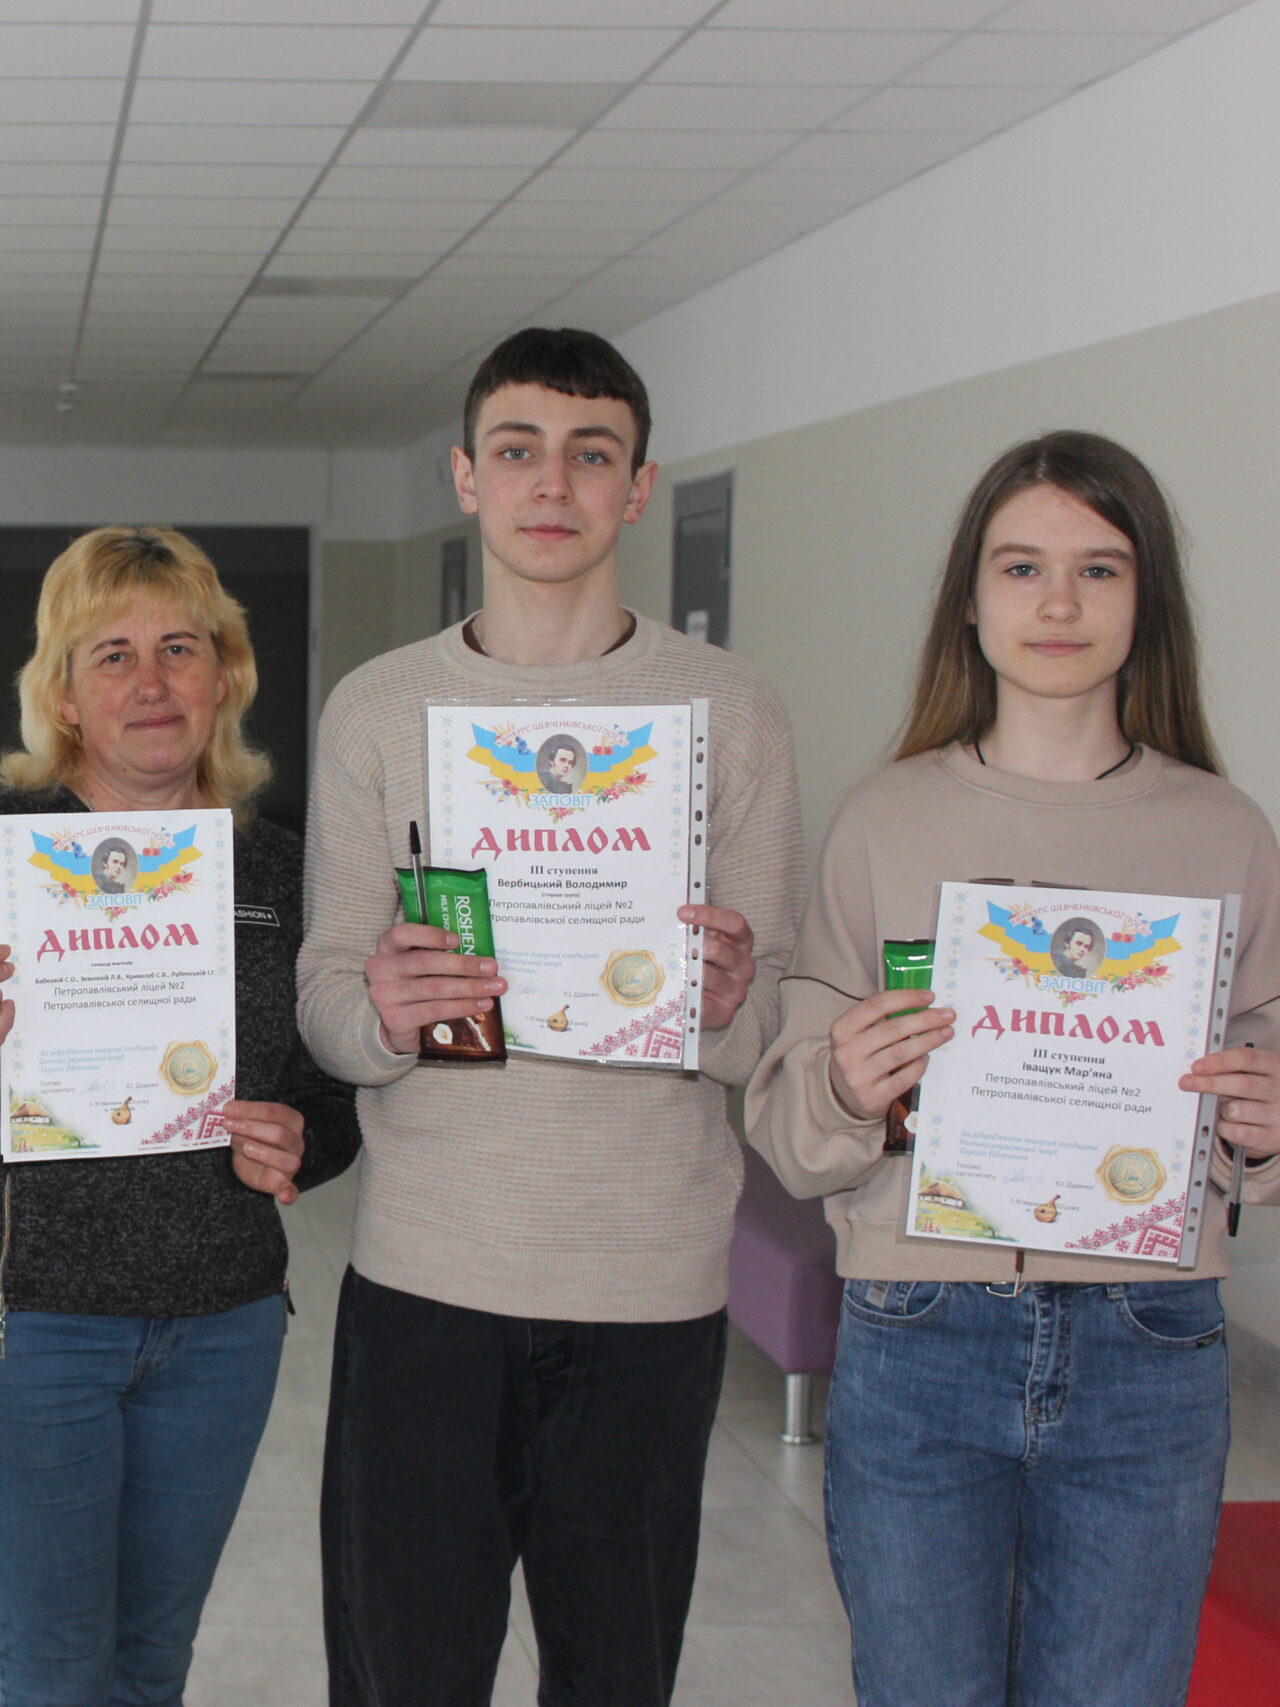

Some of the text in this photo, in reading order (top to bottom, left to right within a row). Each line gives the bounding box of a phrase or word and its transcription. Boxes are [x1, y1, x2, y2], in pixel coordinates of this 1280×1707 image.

[532, 721, 602, 735] ШЕВЧЕНКІВСЬКОЇ
[530, 794, 593, 808] ЗАПОВІТ
[471, 827, 651, 861] ДИПЛОМ
[547, 867, 598, 877] ступення
[498, 879, 628, 890] Вербицький Володимир
[87, 893, 144, 908] ЗАПОВІТ
[440, 895, 449, 912] MILK
[489, 899, 633, 911] Петропавлівський ліцей №2
[234, 910, 267, 919] ASHION
[490, 914, 645, 925] тропавлівської селищної ради
[1050, 904, 1124, 921] ШЕВЧЕНКІВСЬКОЇ
[455, 896, 476, 956] ROSHEN
[36, 923, 199, 963] ДИПЛОМ
[54, 981, 185, 997] Петропавлівський ліцей №2
[1040, 976, 1107, 993] ЗАПОВІТ
[44, 995, 197, 1012] Петропавлівської селищної ради
[971, 1004, 1165, 1046] ДИПЛОМ
[1051, 1052, 1106, 1065] ступення
[1022, 1062, 1061, 1075] Іващук
[985, 1073, 1141, 1097] Петропавлівський ліцей №2
[971, 1086, 1152, 1114] Петропавлівської селищної ради
